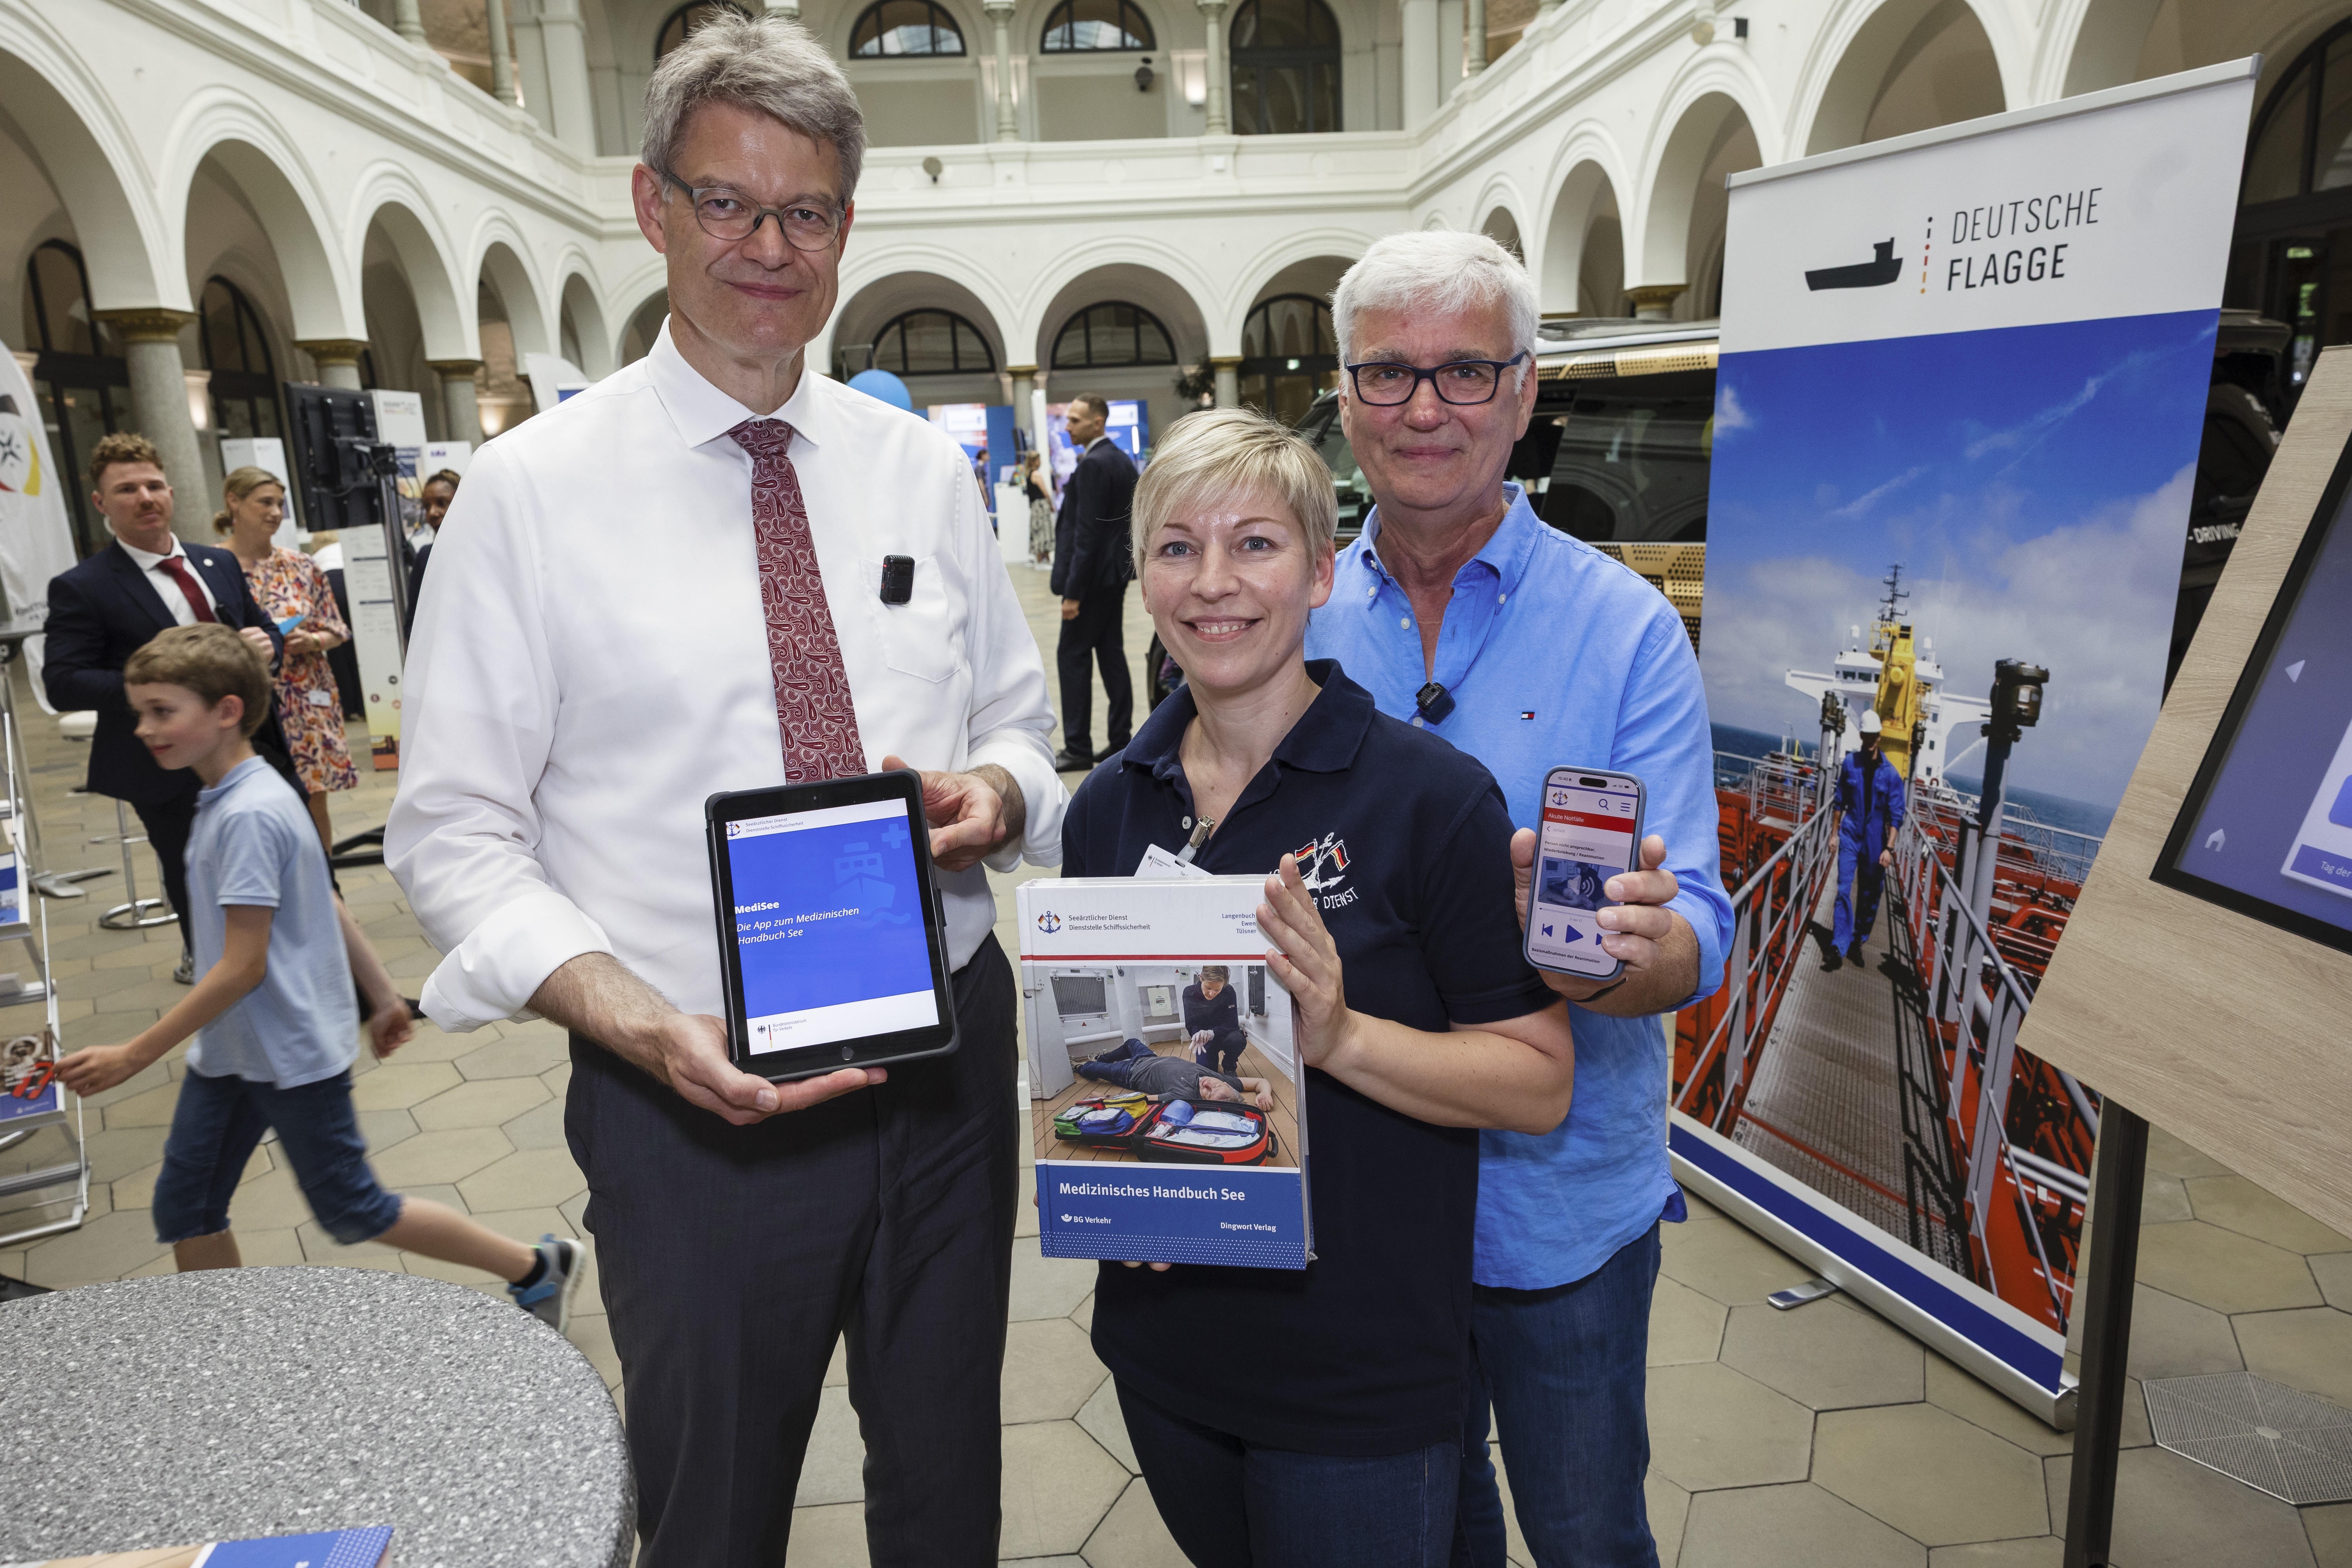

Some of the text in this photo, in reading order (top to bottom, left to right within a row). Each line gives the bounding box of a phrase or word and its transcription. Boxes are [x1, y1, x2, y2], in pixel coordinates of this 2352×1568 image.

[1952, 187, 2102, 244] DEUTSCHE
[1947, 243, 2068, 291] FLAGGE
[1544, 848, 1575, 857] Wiederbelebung
[2321, 861, 2352, 877] Tag der
[1323, 887, 1358, 909] DIENST
[735, 902, 780, 914] MediSee
[737, 907, 859, 932] Die App zum Medizinischen
[738, 929, 803, 945] Handbuch See
[1532, 947, 1566, 957] Basismaßnahmen
[773, 1019, 806, 1027] Bundesministerium
[1060, 1183, 1245, 1201] Medizinisches Handbuch See
[1220, 1222, 1276, 1232] Dingwort Verlag
